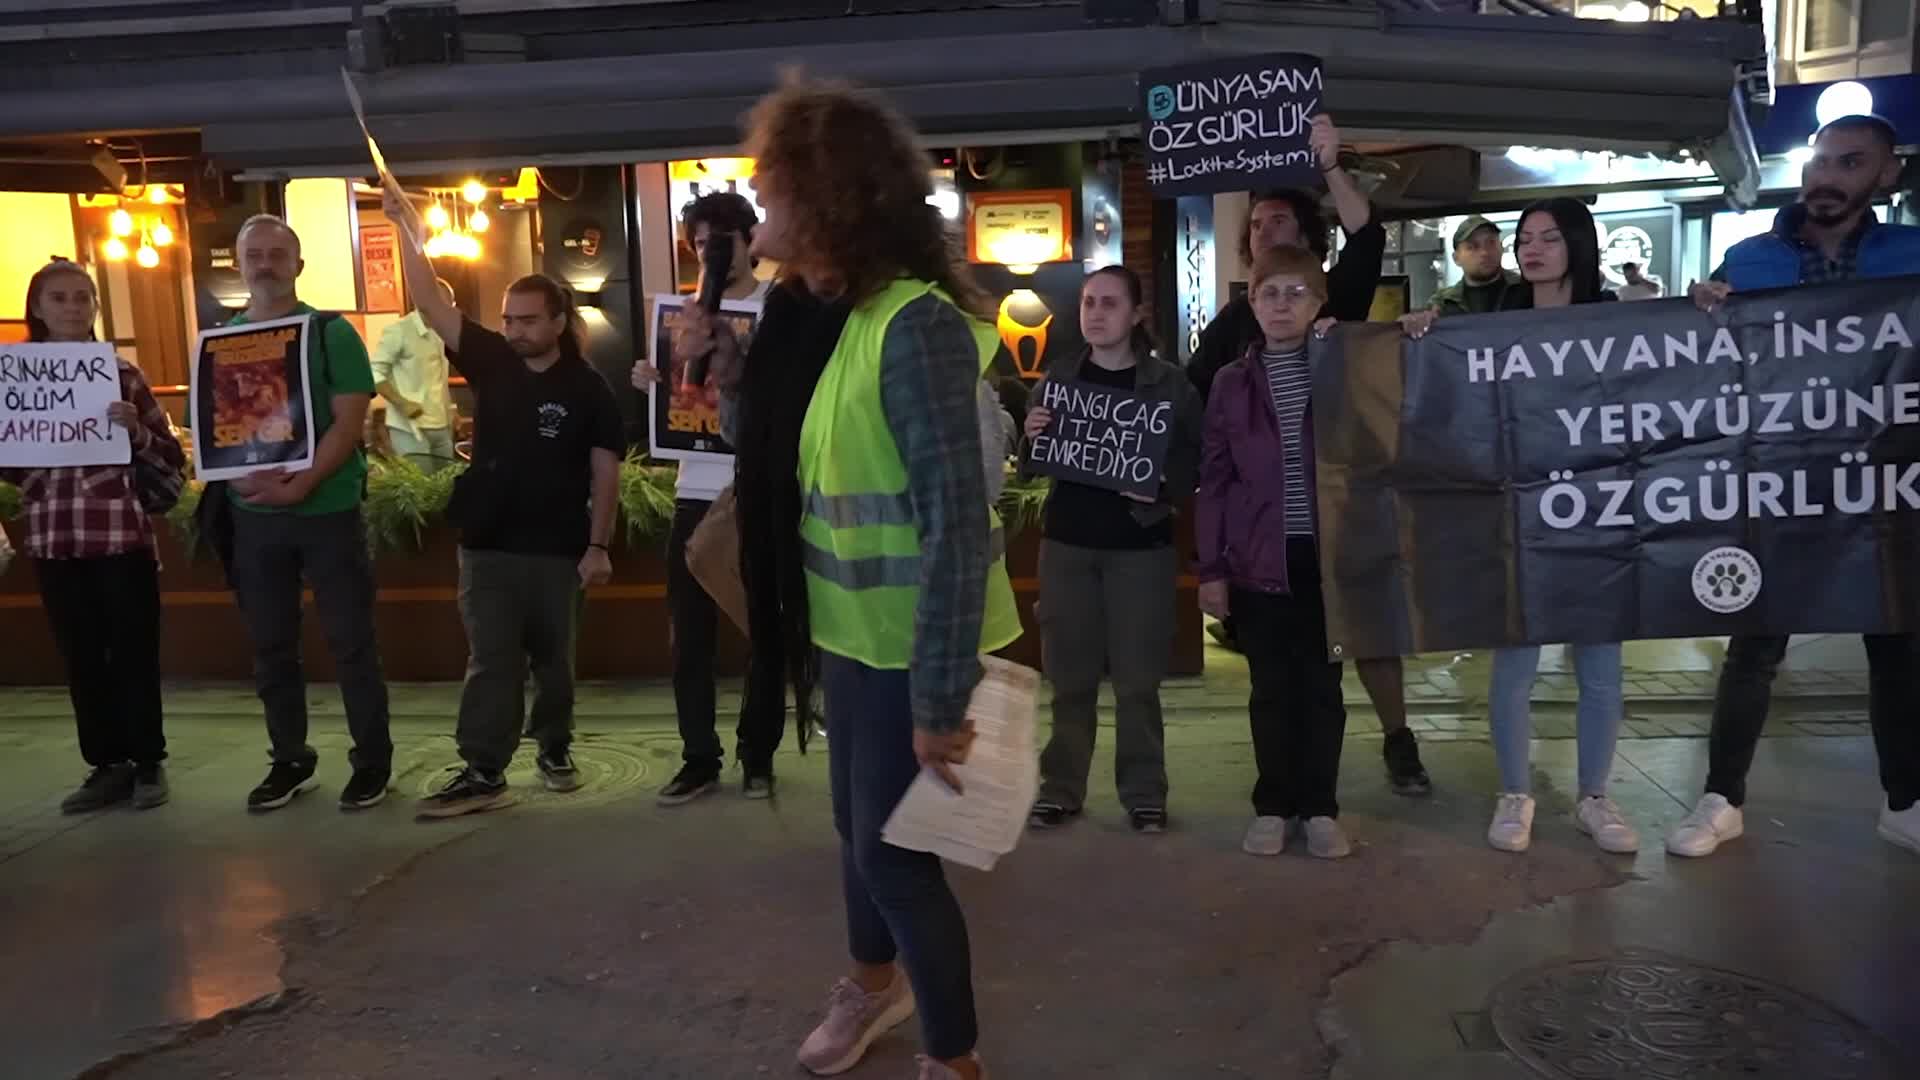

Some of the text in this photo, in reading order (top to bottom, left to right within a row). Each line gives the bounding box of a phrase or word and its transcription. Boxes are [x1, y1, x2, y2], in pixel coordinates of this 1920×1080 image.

[1149, 97, 1319, 152] ÖZGÜRLÜK
[0, 353, 113, 383] RINAKLAR
[1466, 310, 1913, 383] HAYVANA, İNSA
[5, 386, 76, 412] ÖLÜM
[1554, 376, 1920, 446] YERYÜZÜNE
[0, 417, 113, 443] AMPIDIR!
[1539, 451, 1920, 530] ÖZGÜRLÜK
